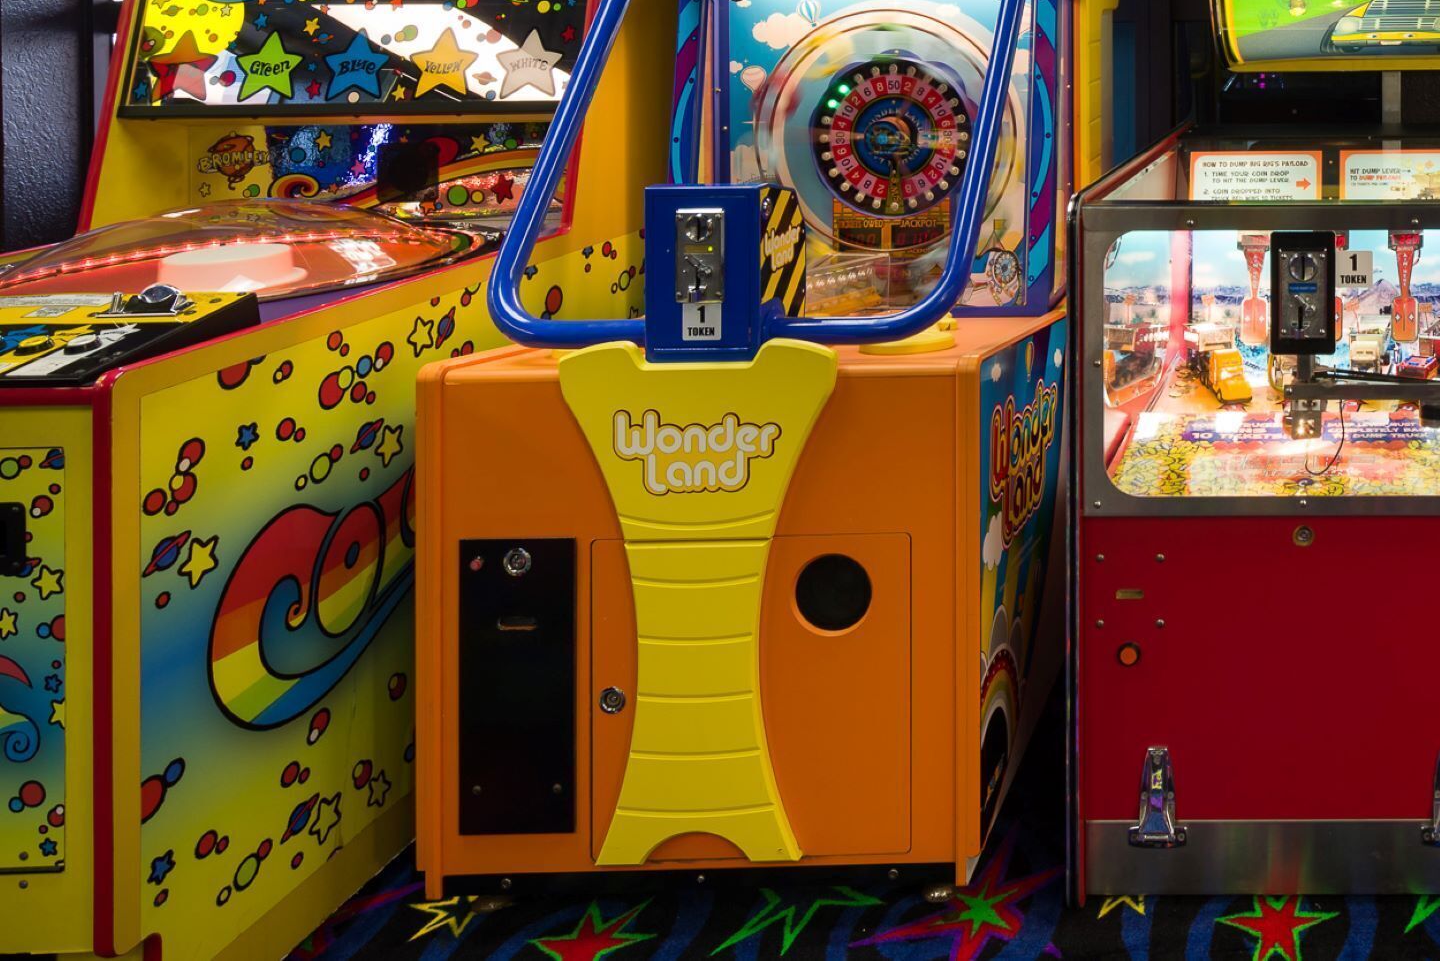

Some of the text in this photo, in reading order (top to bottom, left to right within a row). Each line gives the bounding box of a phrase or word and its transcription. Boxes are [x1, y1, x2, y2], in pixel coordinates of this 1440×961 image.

[198, 150, 270, 172] BROMLEY
[863, 219, 883, 228] OWED
[900, 219, 937, 228] JACKPOT
[1350, 254, 1358, 271] 1
[1340, 275, 1367, 284] TOKEN
[696, 306, 705, 323] 1
[687, 327, 715, 336] TOKEN
[615, 412, 780, 456] Wonder
[647, 449, 745, 493] Land
